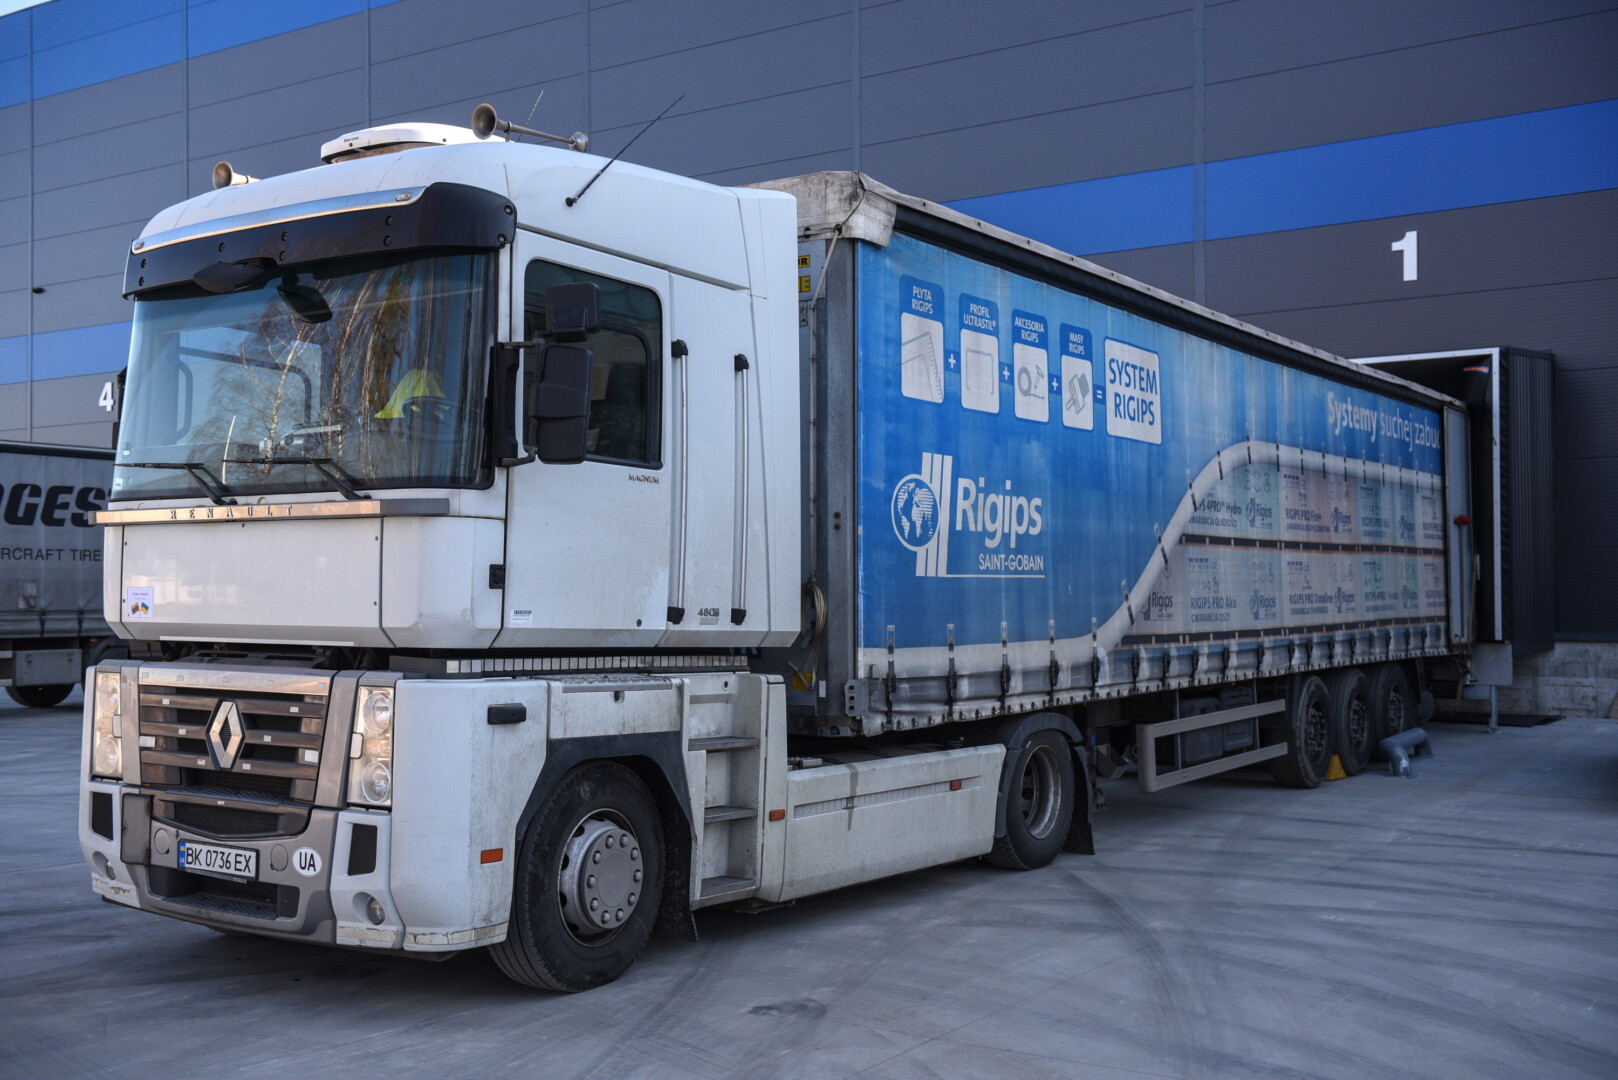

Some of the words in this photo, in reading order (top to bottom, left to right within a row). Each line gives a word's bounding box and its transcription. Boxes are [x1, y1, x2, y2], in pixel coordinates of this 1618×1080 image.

[1391, 230, 1418, 282] 1
[912, 285, 932, 301] PŁYTA
[911, 298, 934, 315] RIGIPS
[969, 302, 991, 319] PROFIL
[1014, 316, 1045, 334] AKCESORIA
[1021, 329, 1039, 344] RIGIPS
[1069, 331, 1084, 345] MASY
[1068, 342, 1086, 356] RIGIPS
[1108, 356, 1158, 396] SYSTEM
[98, 382, 114, 412] 4
[1114, 398, 1156, 427] RIGIPS
[1327, 391, 1378, 443] Systemy
[1380, 407, 1413, 453] suchej
[628, 473, 660, 485] MAGNUM
[0, 483, 112, 528] GES
[170, 504, 293, 520] RENAULT
[956, 477, 1043, 549] Rigips
[1256, 503, 1273, 521] Rigips
[978, 554, 1044, 571] SAINT-GOBAIN
[1151, 591, 1174, 612] Rigips
[1190, 597, 1211, 610] RIGIPS
[1212, 597, 1225, 609] PRO
[1225, 595, 1237, 609] Aku
[1260, 594, 1277, 613] Rigips
[185, 847, 202, 867] BK
[205, 849, 232, 870] 0736
[234, 853, 252, 874] EX
[299, 852, 317, 872] UA
